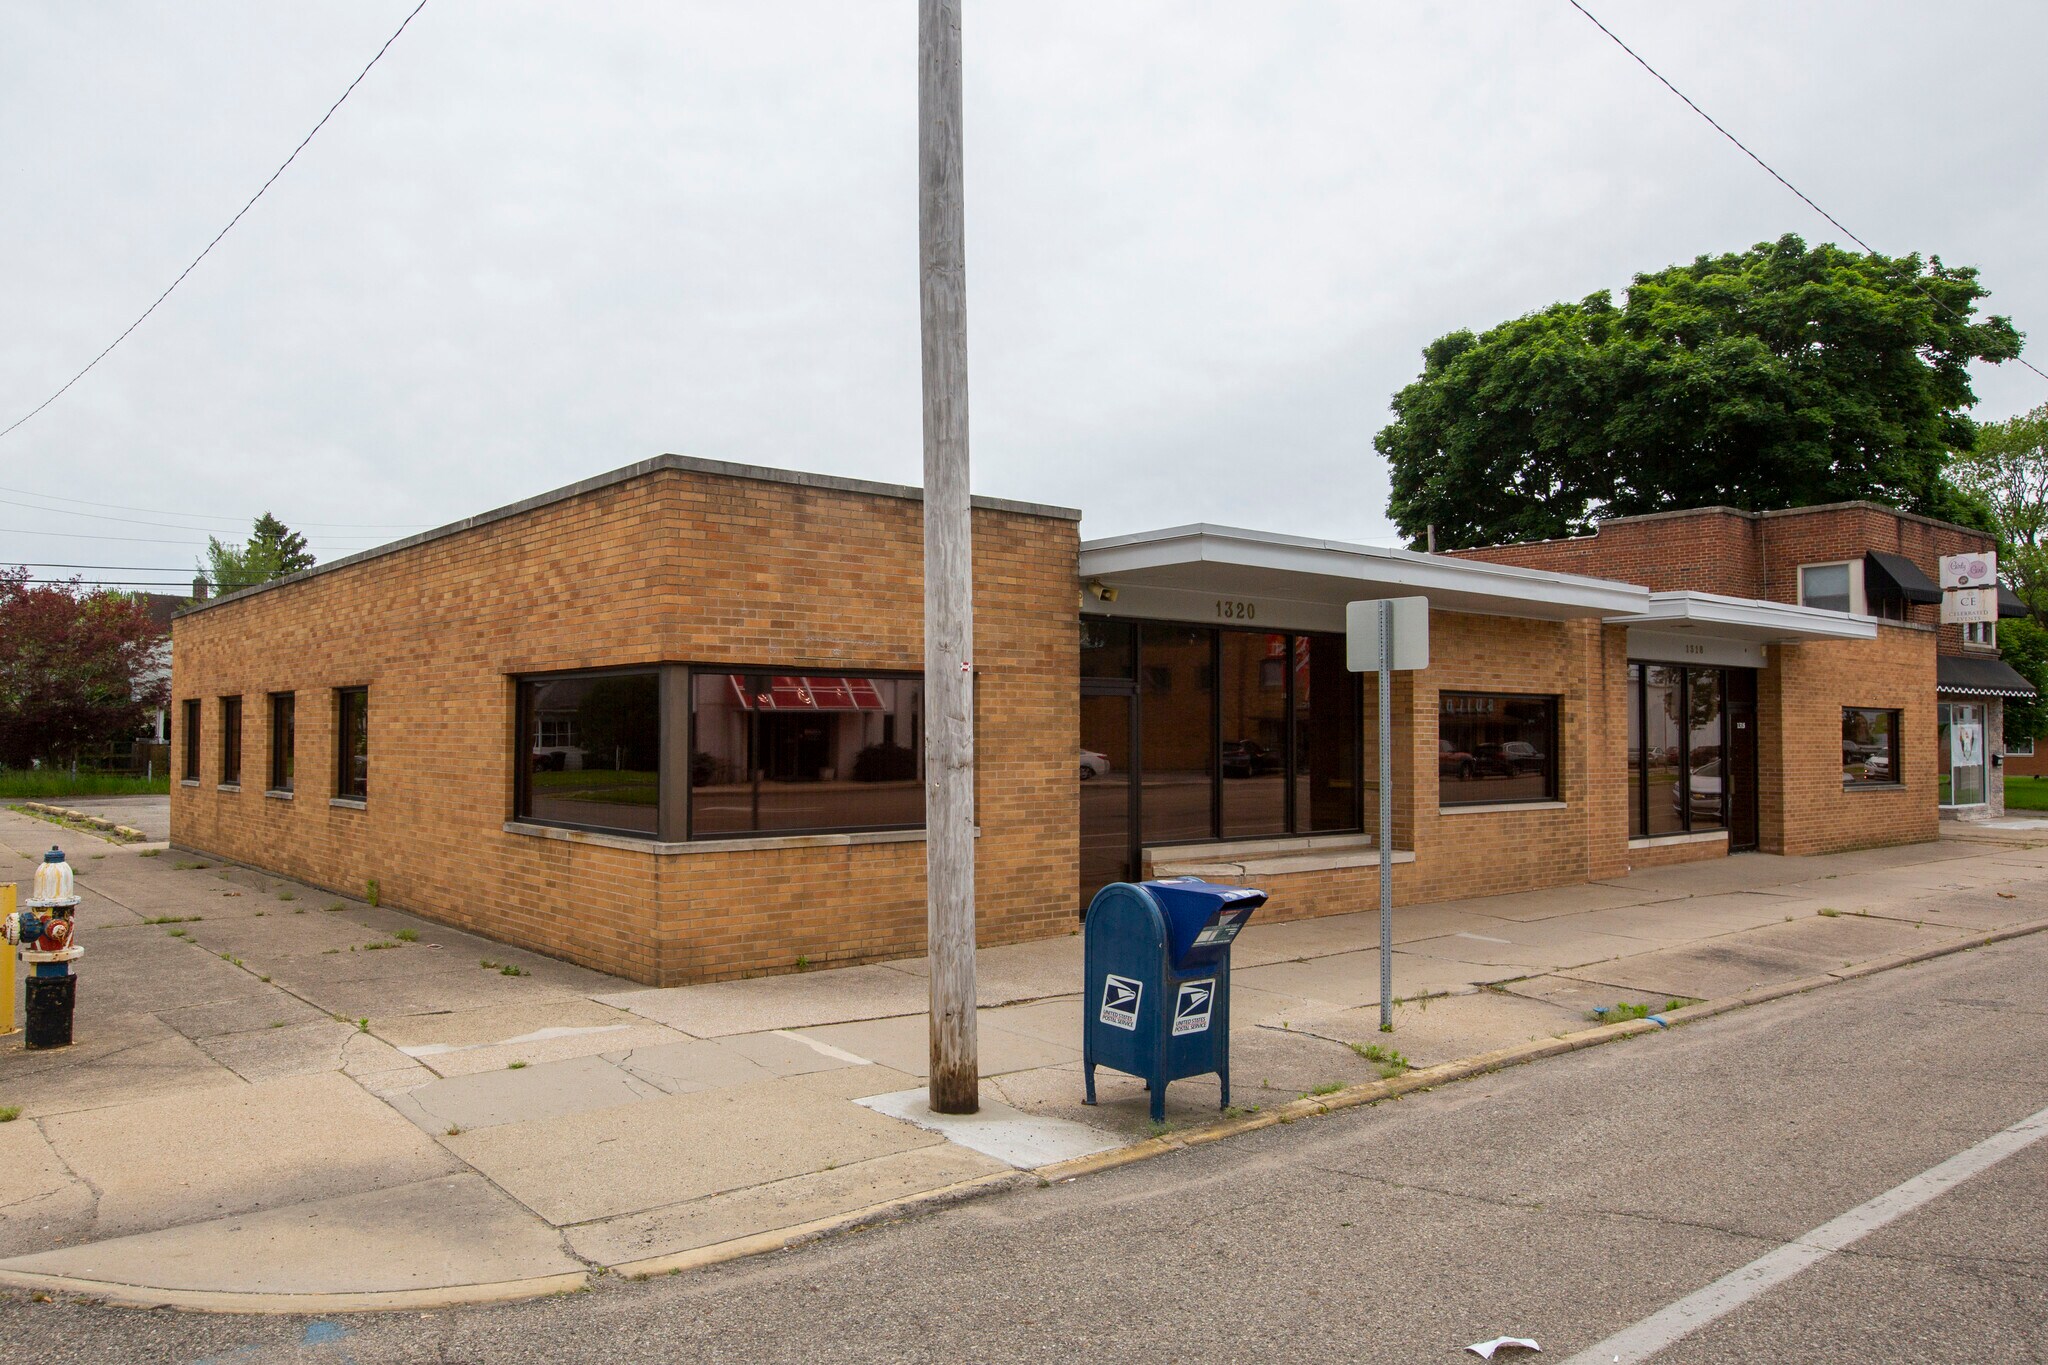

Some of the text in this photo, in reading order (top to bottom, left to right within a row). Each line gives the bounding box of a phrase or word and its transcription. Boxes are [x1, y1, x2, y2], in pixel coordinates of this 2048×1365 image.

[1950, 561, 1984, 574] Girly Girl
[1960, 597, 1976, 606] CE
[1216, 600, 1254, 619] 1320
[1686, 644, 1704, 654] 1318
[1102, 1014, 1134, 1027] POSTAL SERVICE
[1103, 1009, 1133, 1021] UNITED STATES
[1175, 1019, 1191, 1027] UNITED
